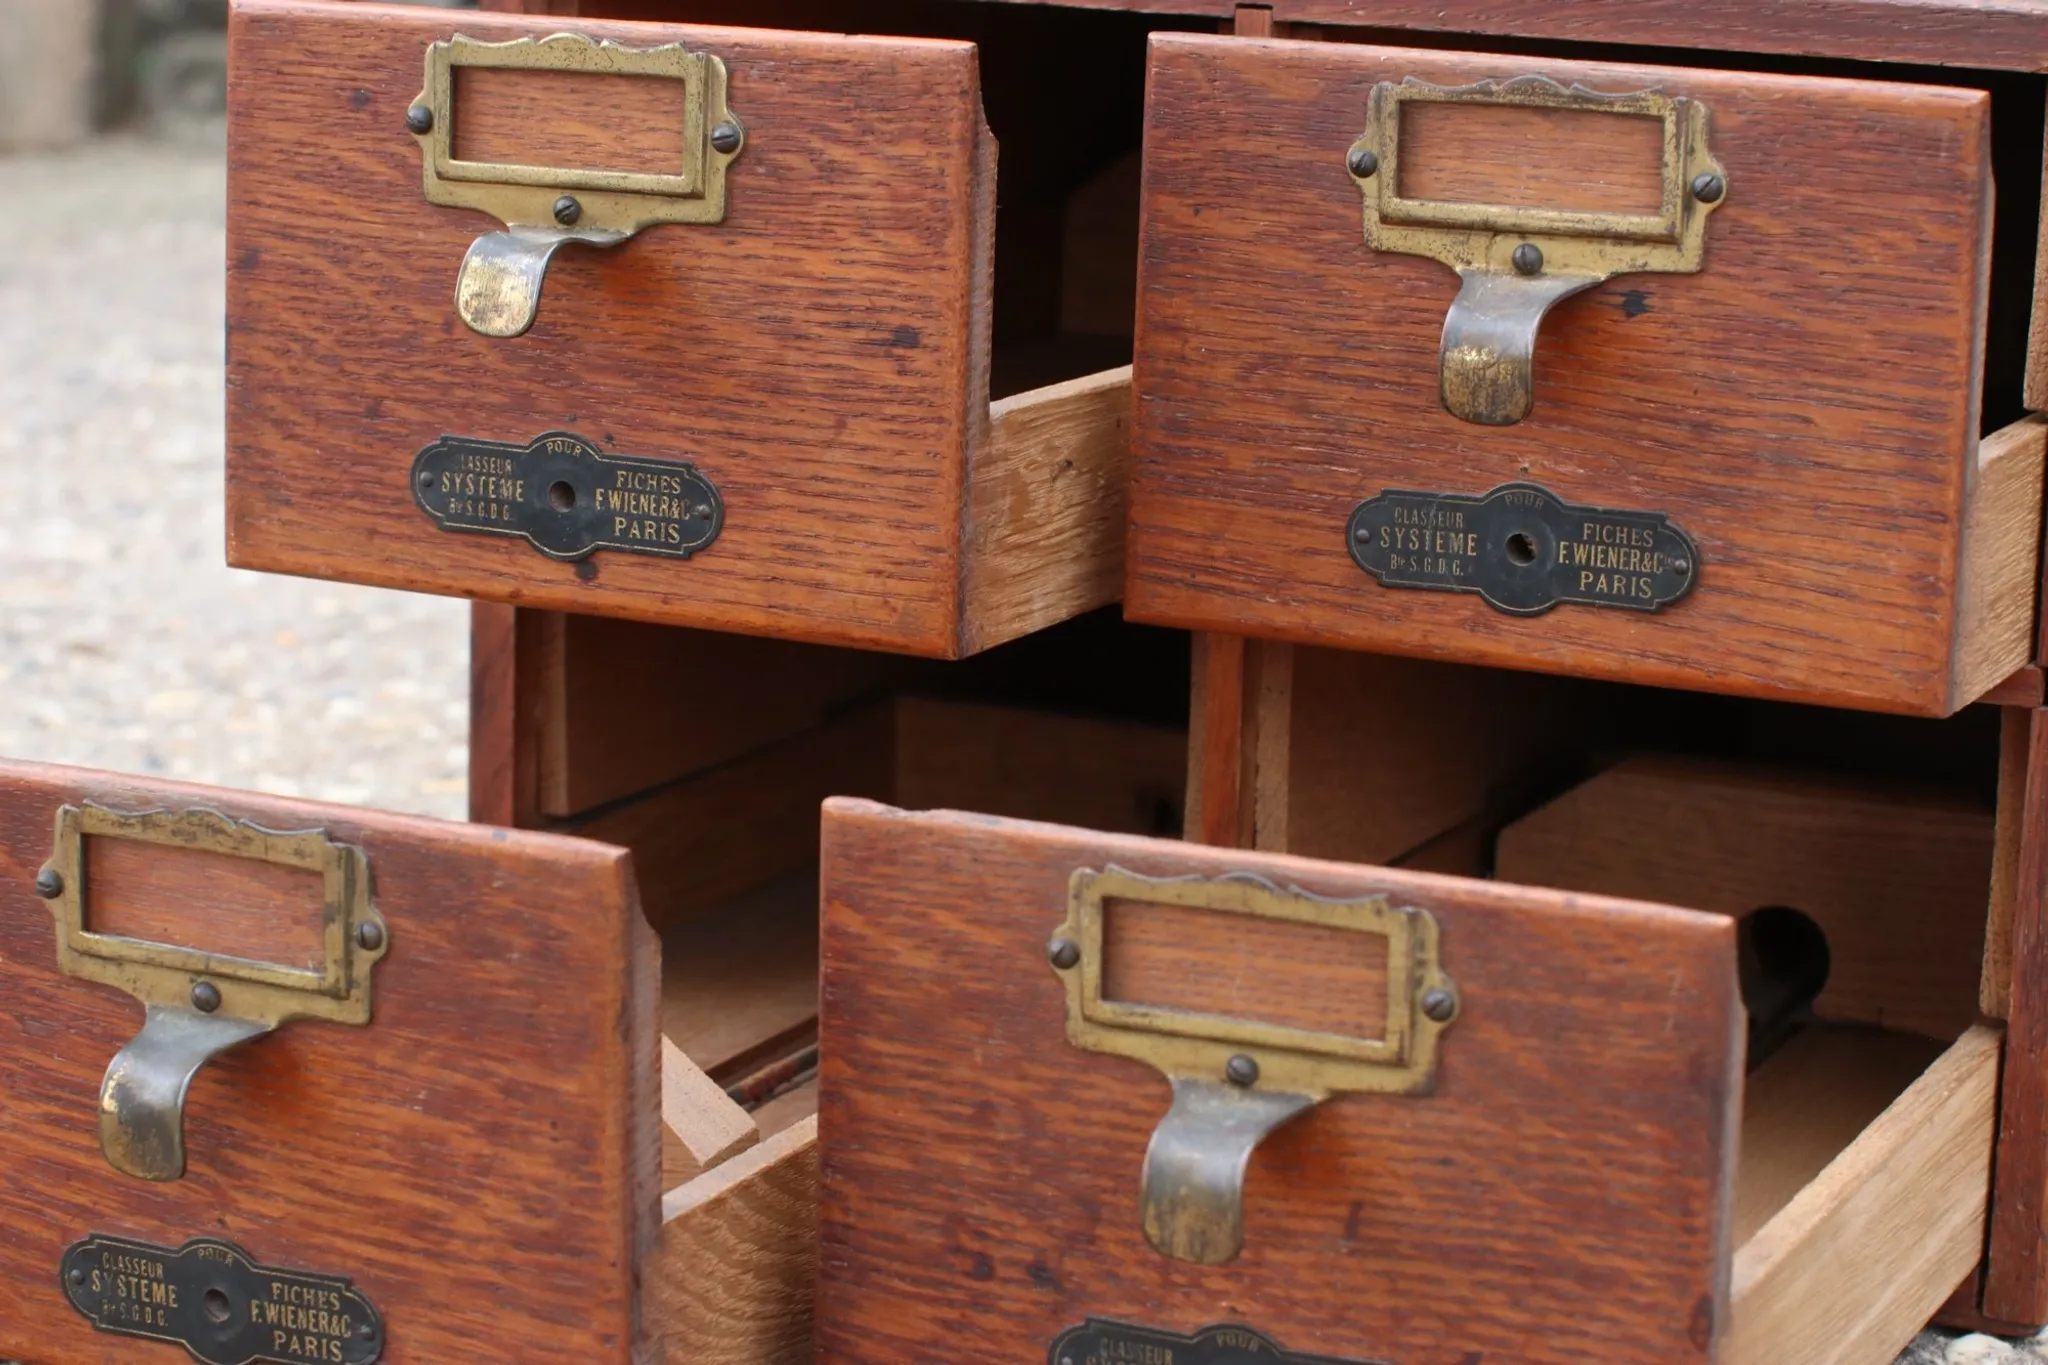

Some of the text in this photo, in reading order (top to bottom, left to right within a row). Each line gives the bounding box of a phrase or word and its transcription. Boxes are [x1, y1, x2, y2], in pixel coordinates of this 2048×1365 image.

[546, 441, 581, 457] POUR
[451, 454, 513, 475] LASSEUR
[441, 471, 525, 502] SYSTEME
[616, 470, 681, 494] FICHES
[1505, 494, 1545, 509] POUR
[614, 517, 681, 544] PARIS
[1394, 507, 1464, 529] CLASSEUR
[1380, 526, 1478, 556] SYSTEME
[1583, 523, 1654, 547] FICHES
[1579, 571, 1652, 598] PARIS
[102, 1251, 164, 1279] CLASSEUR
[198, 1247, 234, 1267] POUR
[91, 1269, 179, 1308] SYSTEME
[271, 1282, 341, 1311] FICHES
[273, 1330, 342, 1362] PARIS
[1216, 1333, 1259, 1352] POUR
